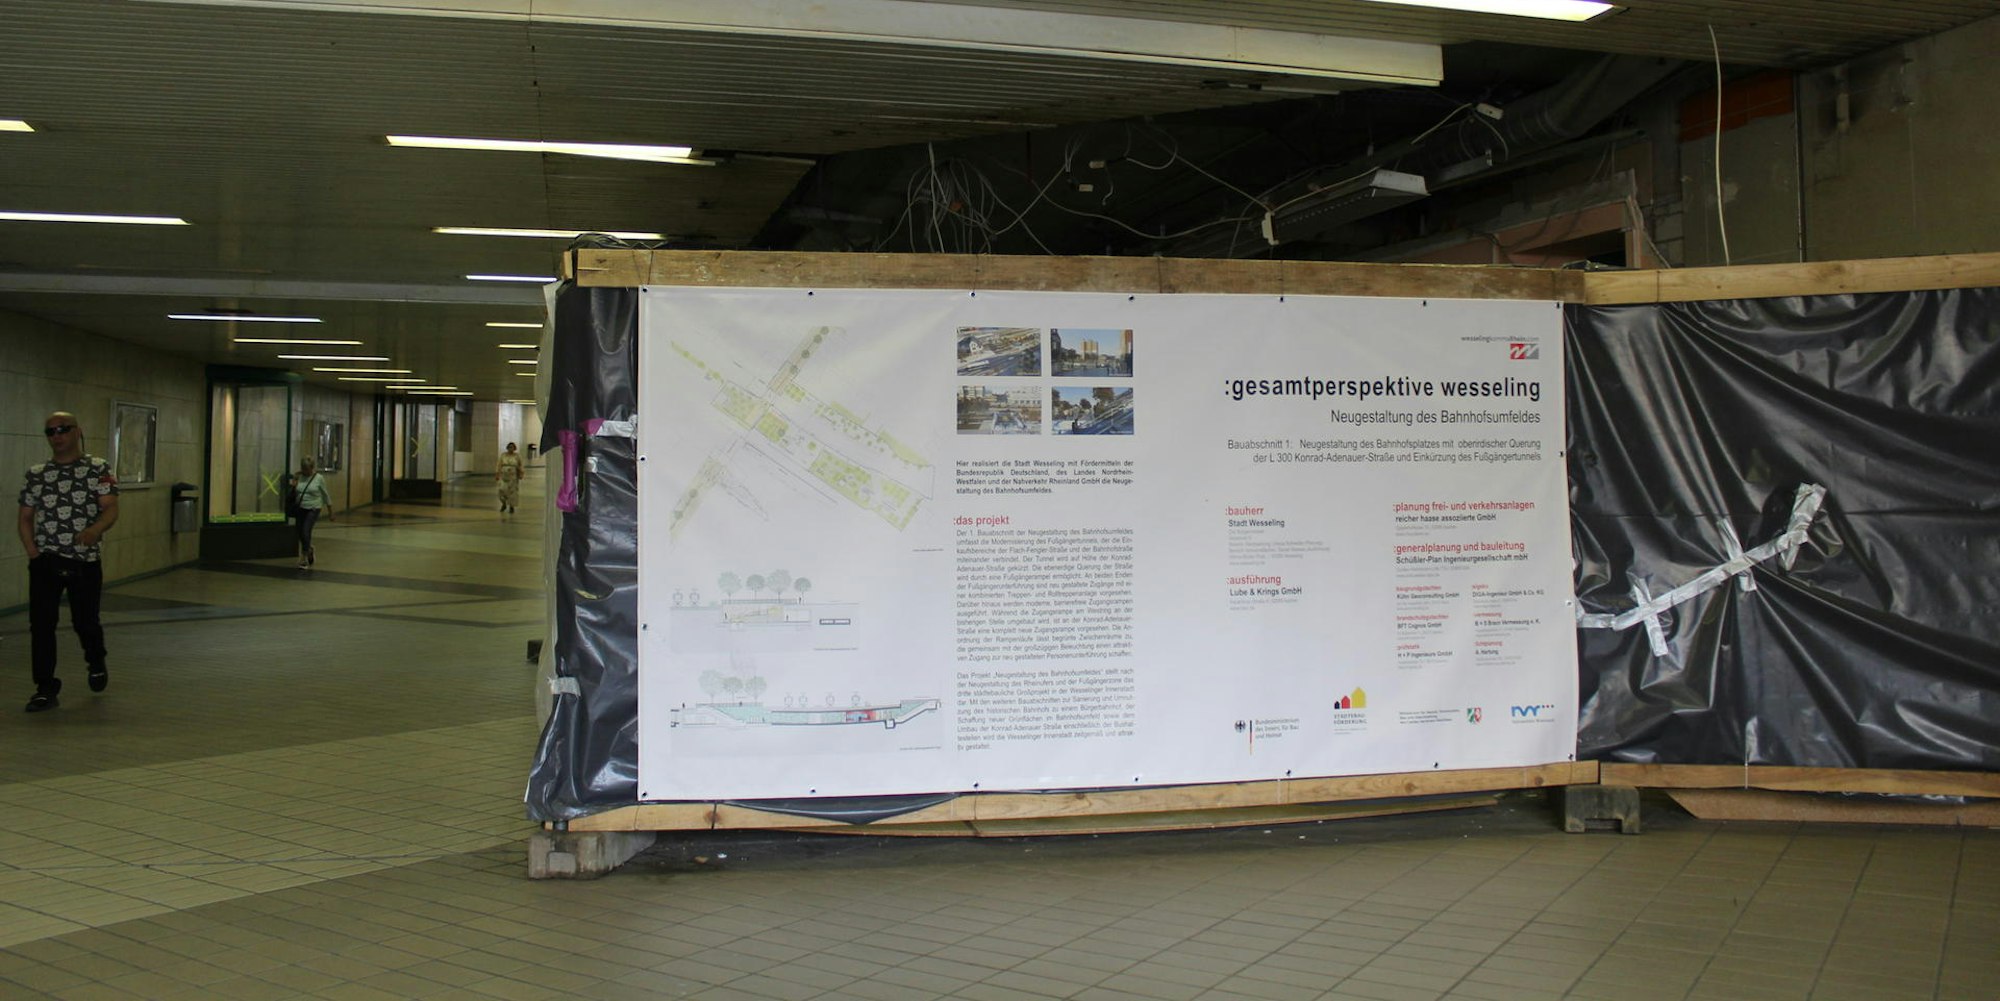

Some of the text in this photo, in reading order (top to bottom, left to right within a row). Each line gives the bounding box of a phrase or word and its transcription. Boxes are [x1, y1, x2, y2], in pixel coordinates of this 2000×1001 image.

[1225, 376, 1541, 402] :gesamtperspektive wesseling
[1331, 410, 1541, 426] Neugestaltung des Bahnhofsumfeldes
[1228, 439, 1541, 451] Bauabschnitt 1: Neugestaltung des Bahnhofsplatzes mit oberirdischer Querung
[1253, 452, 1541, 464] der L 300 Konrad-Adenauer-Straße und Einkürzung des Fußgängertunnels
[1033, 460, 1064, 468] Wesseling
[956, 469, 1004, 478] Bundesrepublik
[1010, 469, 1049, 477] Deutschland,
[1112, 478, 1133, 486] Neuge-
[1226, 506, 1264, 516] :bauherr
[1393, 501, 1534, 513] :planung frei- und verkehrsanlagen
[953, 515, 1009, 526] :das projekt
[1249, 519, 1285, 528] Wesseling
[1394, 544, 1461, 554] :generalplanung
[1480, 542, 1524, 552] bauleitung
[1396, 556, 1442, 564] Schüßler-Plan
[1444, 554, 1511, 564] Ingenieurgesellschaft
[1227, 575, 1281, 585] :ausführung
[1257, 588, 1279, 597] Krings
